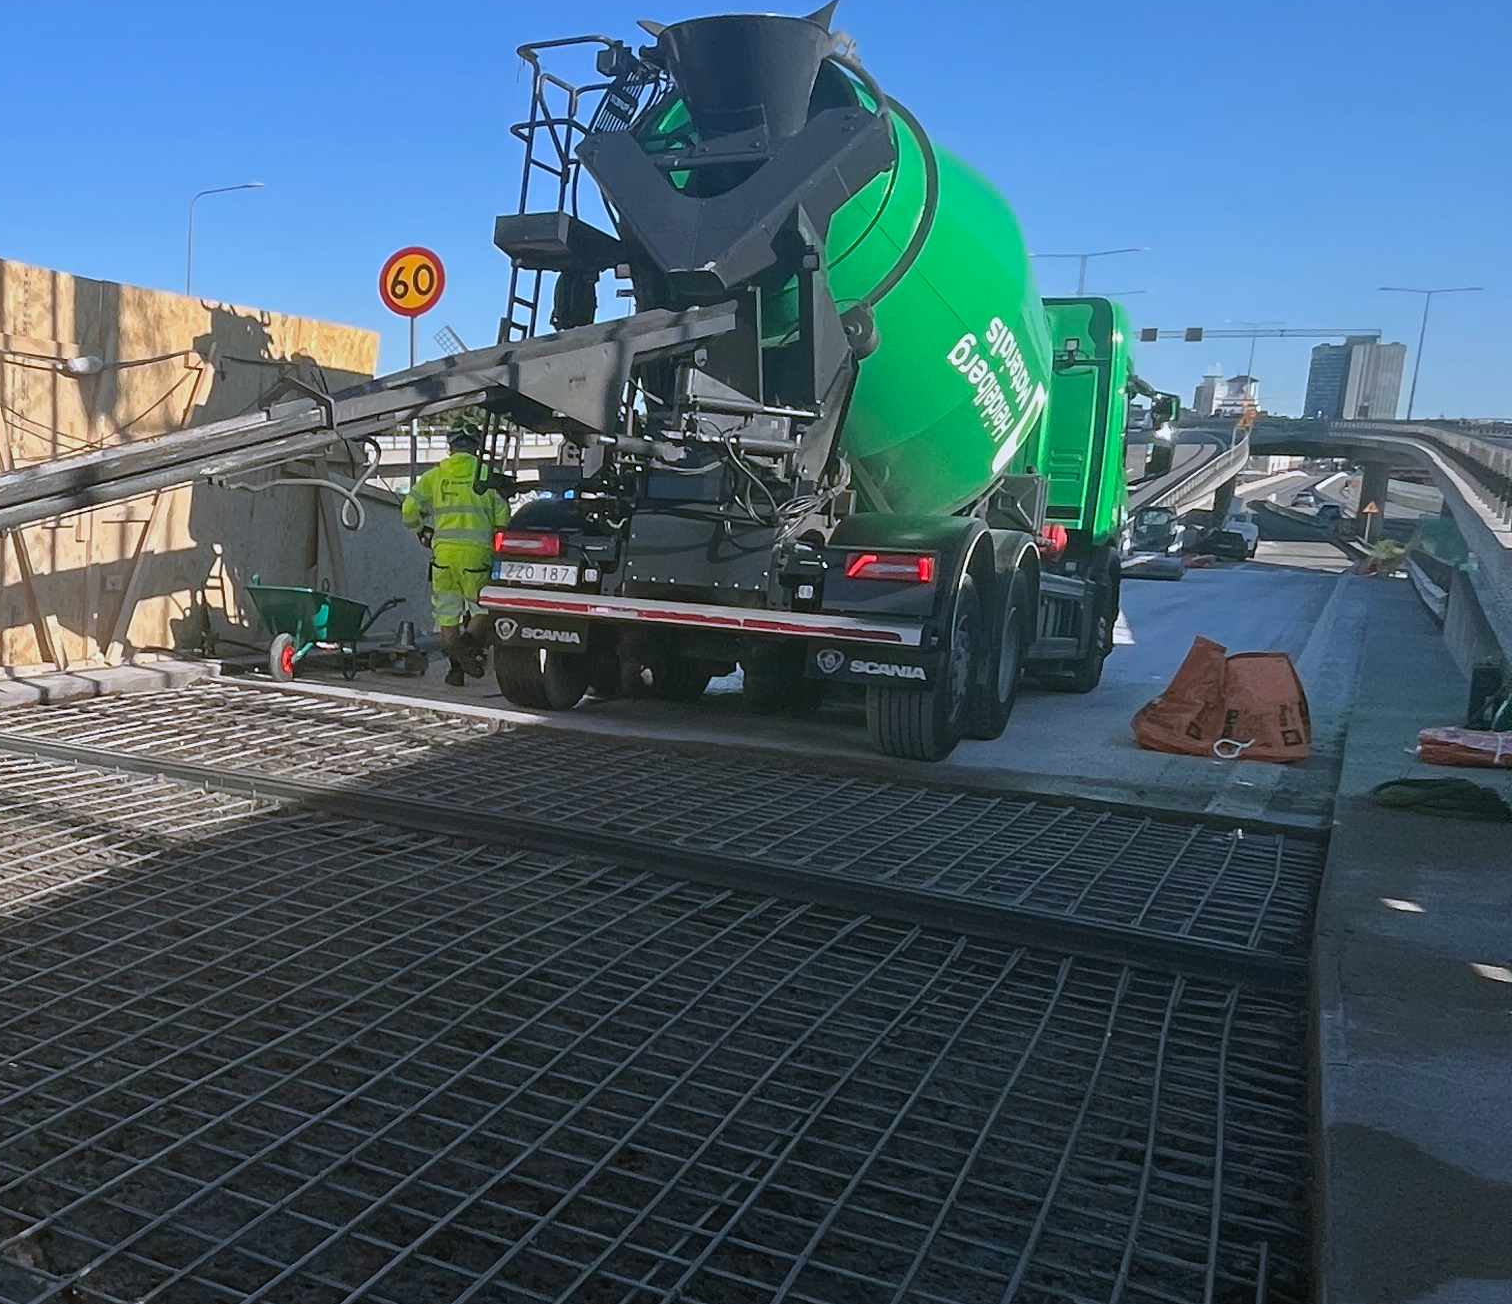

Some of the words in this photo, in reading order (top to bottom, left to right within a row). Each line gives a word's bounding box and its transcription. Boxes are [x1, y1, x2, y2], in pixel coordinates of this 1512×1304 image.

[390, 263, 435, 300] 60
[985, 316, 1033, 412] Materials
[947, 332, 1015, 443] Heidelberg
[542, 566, 570, 582] 187
[521, 627, 581, 644] SCANIA
[849, 660, 927, 681] SCANIA
